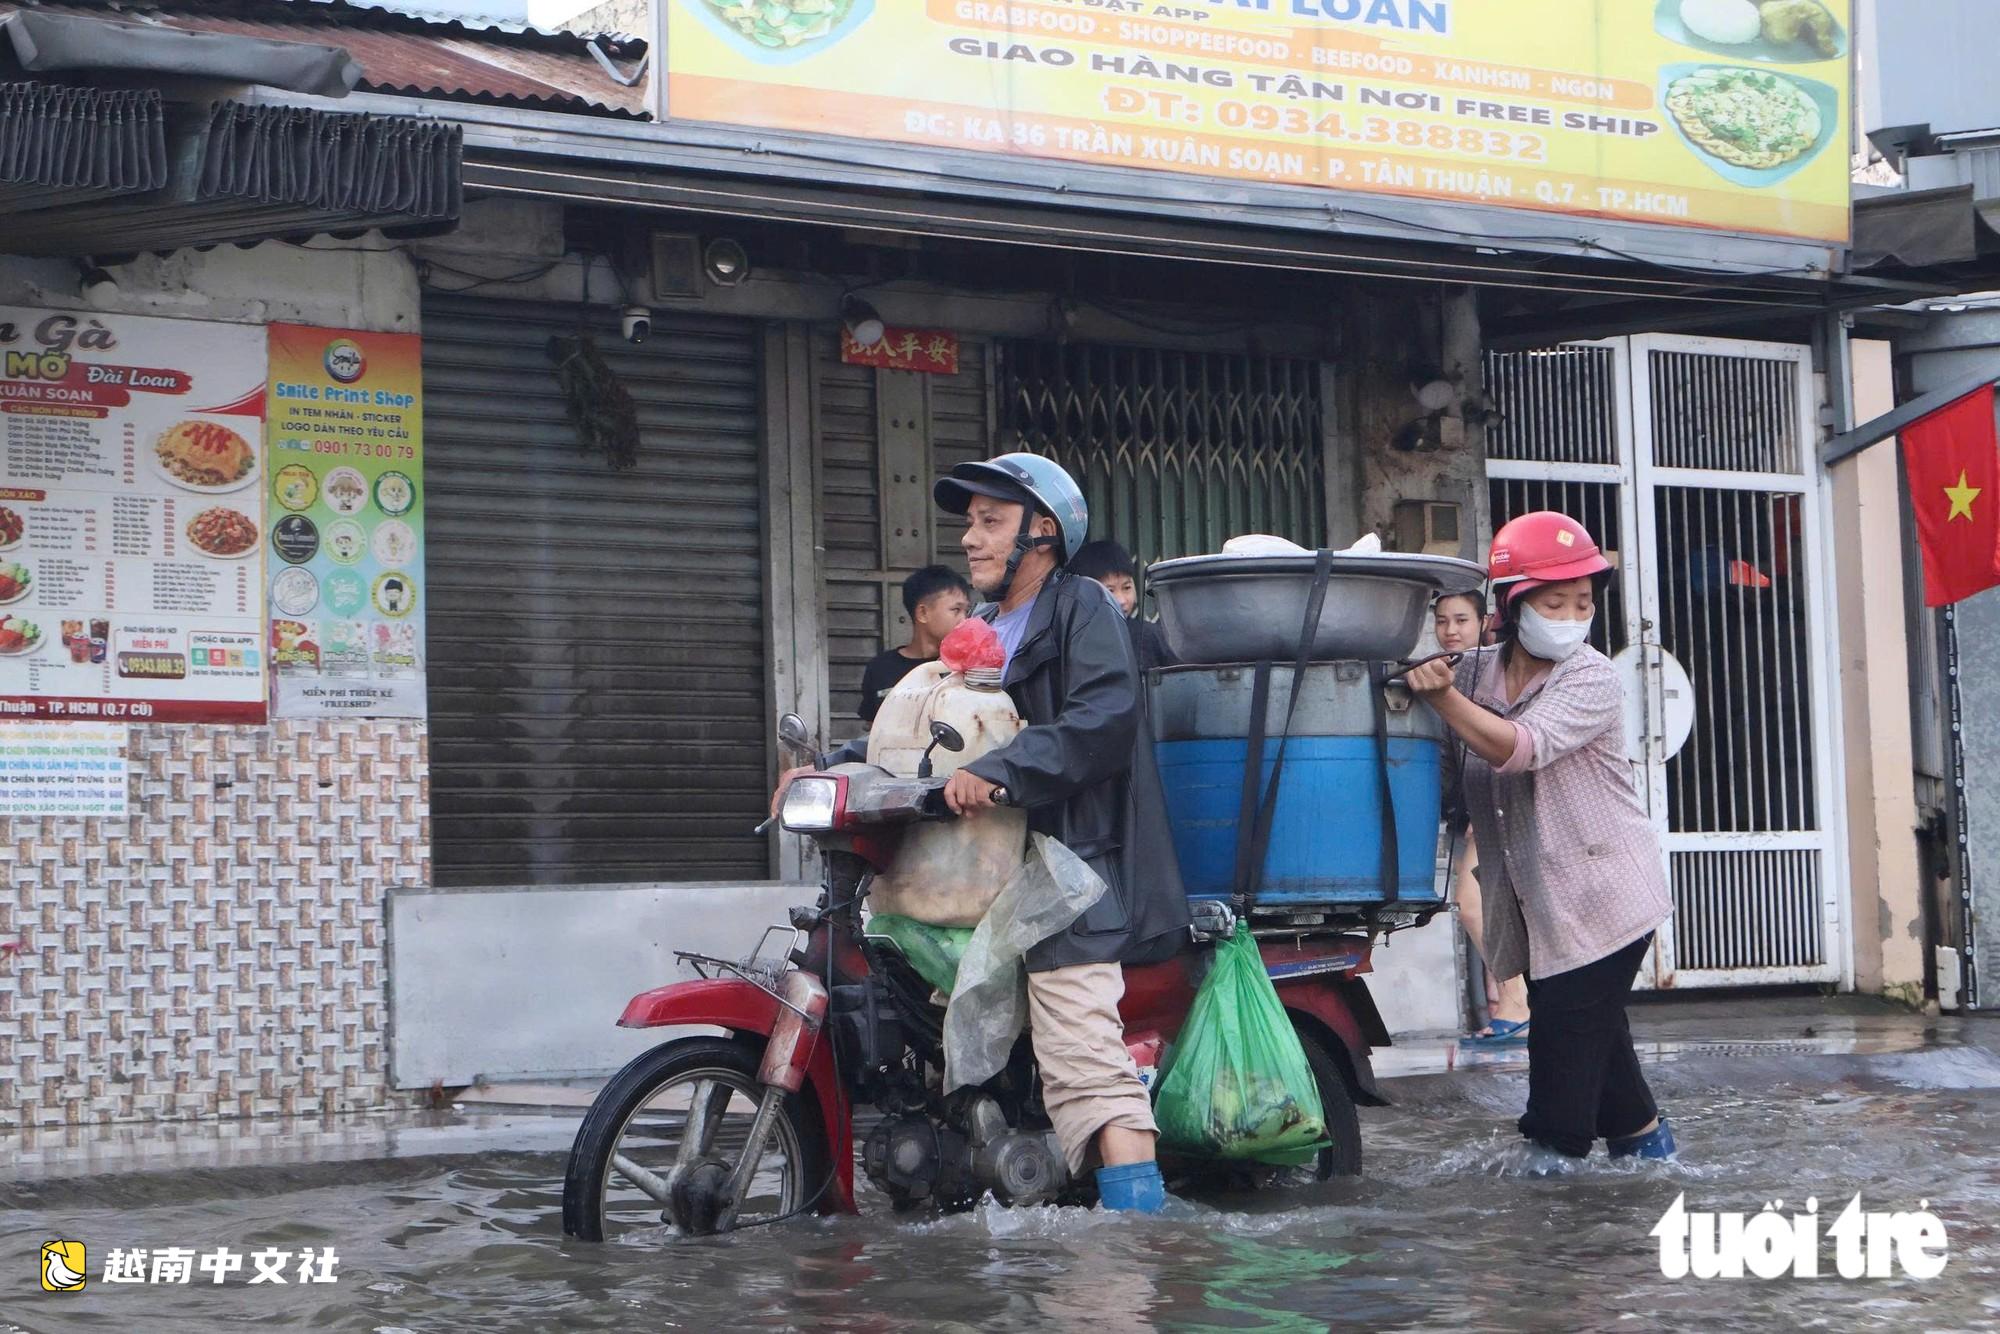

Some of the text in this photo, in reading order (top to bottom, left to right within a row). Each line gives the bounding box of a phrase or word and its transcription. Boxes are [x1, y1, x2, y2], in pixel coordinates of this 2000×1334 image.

[1153, 6, 1209, 20] APP
[956, 2, 1098, 34] GRABFOOD
[1119, 21, 1288, 59] SHOPPEEFOOD
[1312, 46, 1413, 75] BEEFOOD
[1434, 62, 1530, 90] XANHSM
[1551, 77, 1614, 99] NGON
[949, 38, 1658, 137] GIAO HÀNG TẬN NƠI FREE SHIP
[1103, 86, 1543, 161] ĐT: 0934.388832
[904, 110, 954, 138] ĐC:
[963, 116, 1004, 143] KA
[1013, 122, 1046, 146] 36
[1054, 124, 1132, 156] TRẦN
[1140, 135, 1221, 167] XUÂN
[1228, 147, 1304, 179] SOẠN
[1328, 158, 1353, 181] P.
[1360, 157, 1414, 187] TÂN
[1422, 168, 1512, 200] THUẬN
[1535, 180, 1576, 205] Q.7
[1596, 186, 1689, 217] TP.HCM
[35, 315, 117, 351] Gà
[88, 366, 177, 388] Đài Loan
[46, 387, 93, 404] SOẠN
[289, 407, 299, 415] IN
[303, 408, 321, 417] TEM
[362, 413, 401, 423] STICKER
[281, 422, 311, 431] LOGO
[338, 426, 364, 435] THEO
[314, 439, 414, 459] 0901 73 00 79
[48, 701, 66, 714] TP.
[68, 702, 99, 715] HCM
